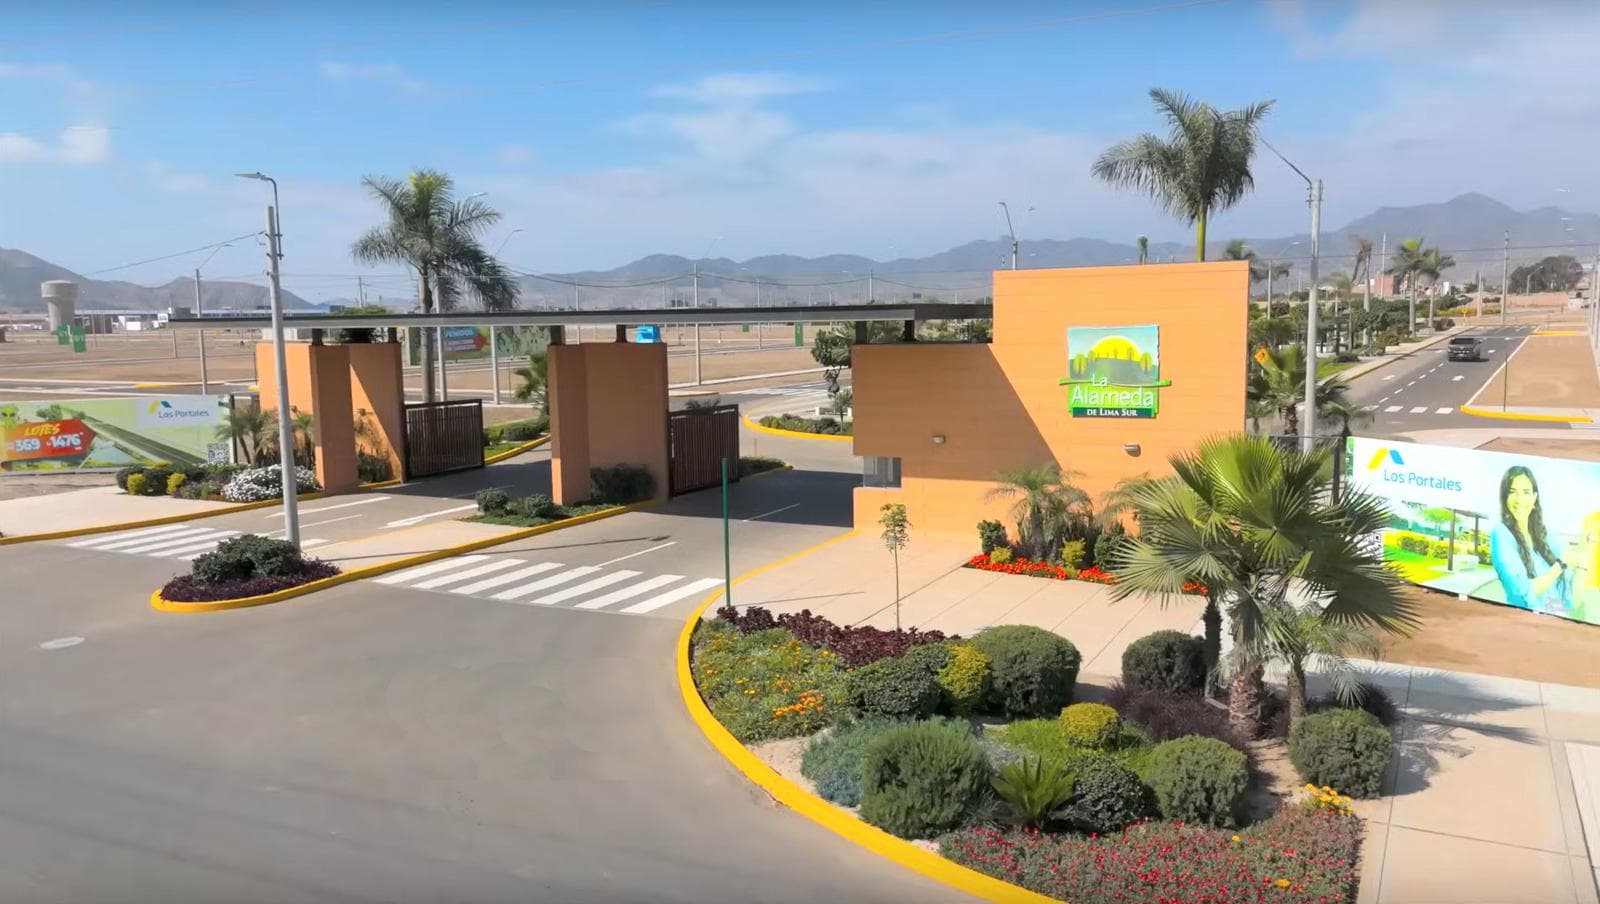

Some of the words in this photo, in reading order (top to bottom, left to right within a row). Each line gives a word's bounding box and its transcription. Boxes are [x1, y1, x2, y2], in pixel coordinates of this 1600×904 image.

[1092, 374, 1107, 387] La
[1072, 386, 1154, 407] Alameda
[158, 410, 174, 418] Los
[175, 409, 210, 418] Portales
[1100, 408, 1120, 416] LIMA
[1121, 408, 1138, 416] SUR
[24, 423, 60, 436] LOTES
[1384, 468, 1405, 484] Los
[1408, 472, 1463, 492] Portales
